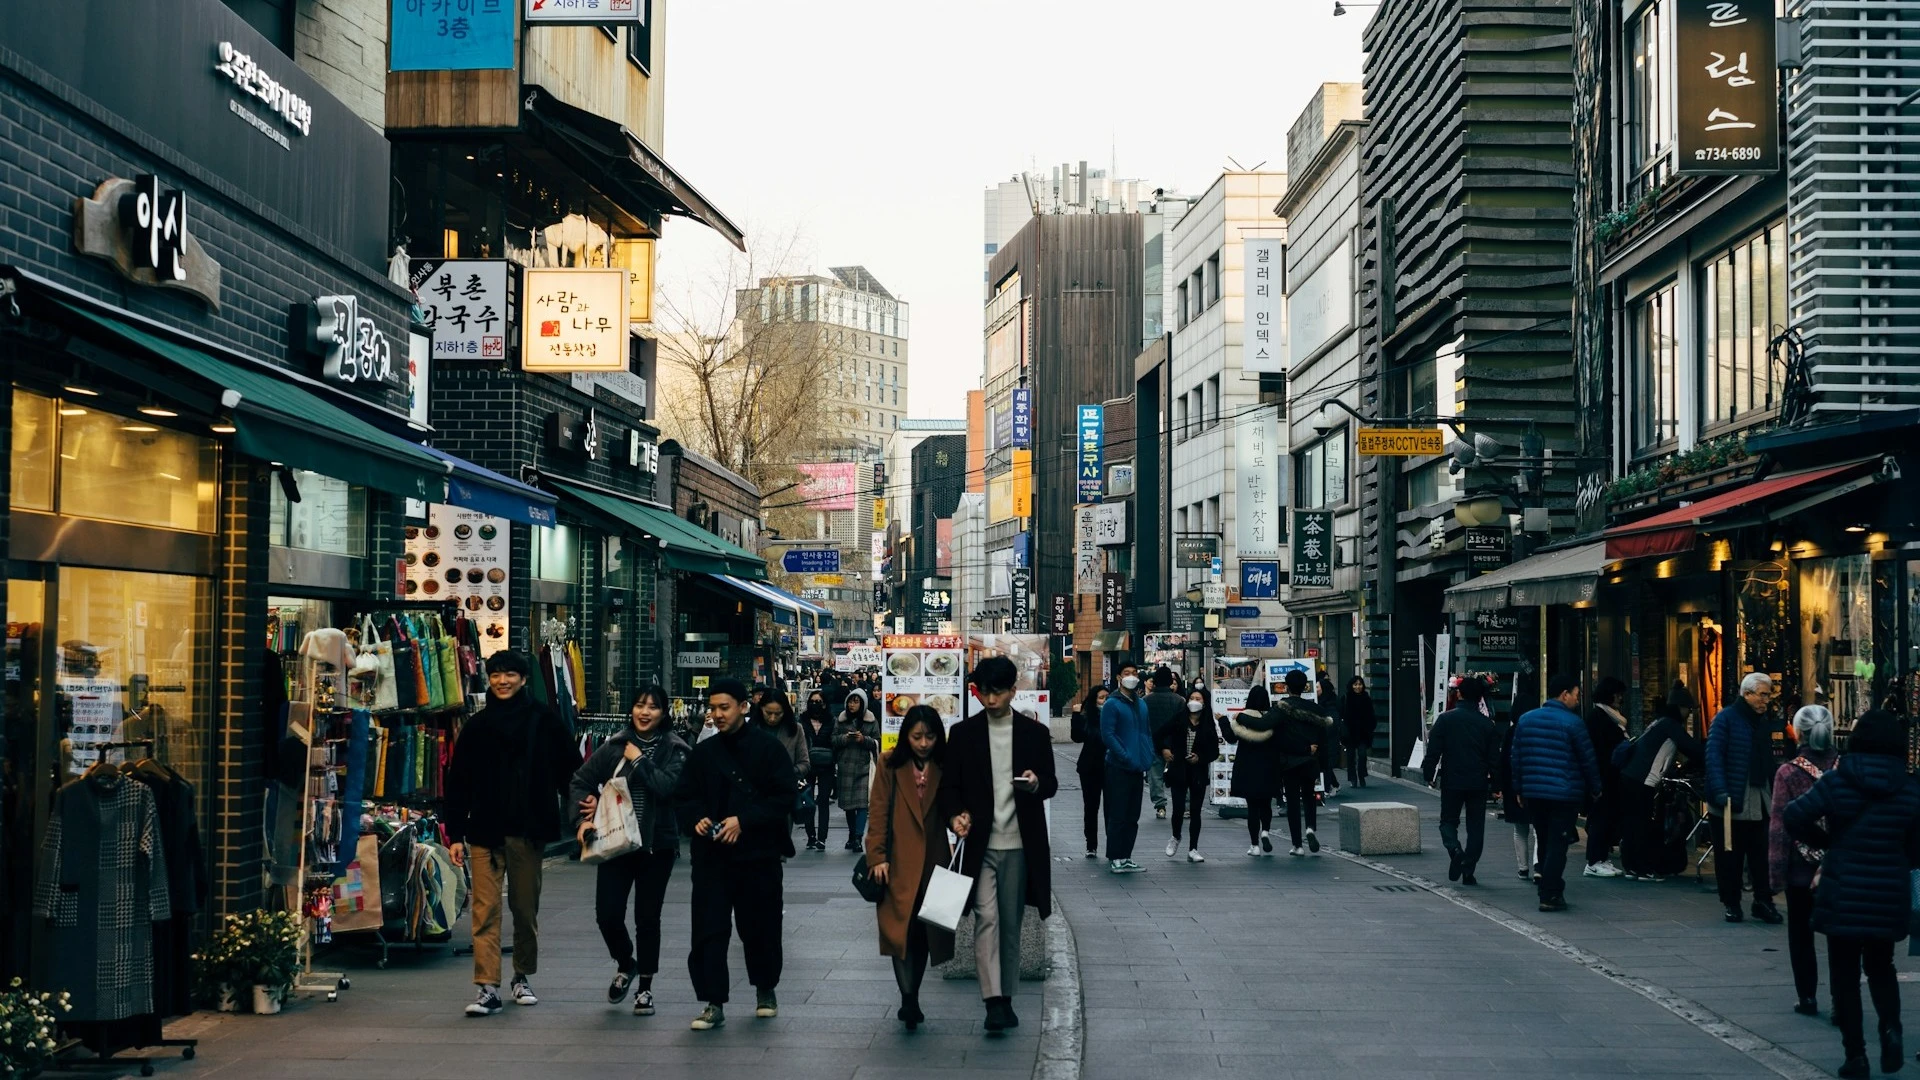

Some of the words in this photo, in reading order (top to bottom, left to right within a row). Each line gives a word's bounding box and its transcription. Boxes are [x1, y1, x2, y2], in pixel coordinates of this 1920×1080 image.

[437, 18, 470, 39] 3층
[1706, 147, 1761, 160] 734-6890
[432, 273, 487, 302] 북촌
[1256, 248, 1270, 298] 갤러리
[573, 317, 612, 333] 나무
[1256, 311, 1270, 360] 인덱스
[435, 341, 478, 354] 지하1층
[550, 343, 597, 357] 전통찻집
[1015, 391, 1028, 437] 세종화랑
[1252, 412, 1265, 467] 도채비도
[1248, 474, 1267, 504] 반한
[1252, 509, 1267, 542] 찻집
[802, 551, 839, 560] 인사동12길
[1055, 596, 1065, 631] 한양화랑
[1106, 579, 1115, 623] 국제자수원
[679, 655, 693, 664] TAL
[694, 655, 719, 664] BANG
[1215, 697, 1240, 705] 47번가
